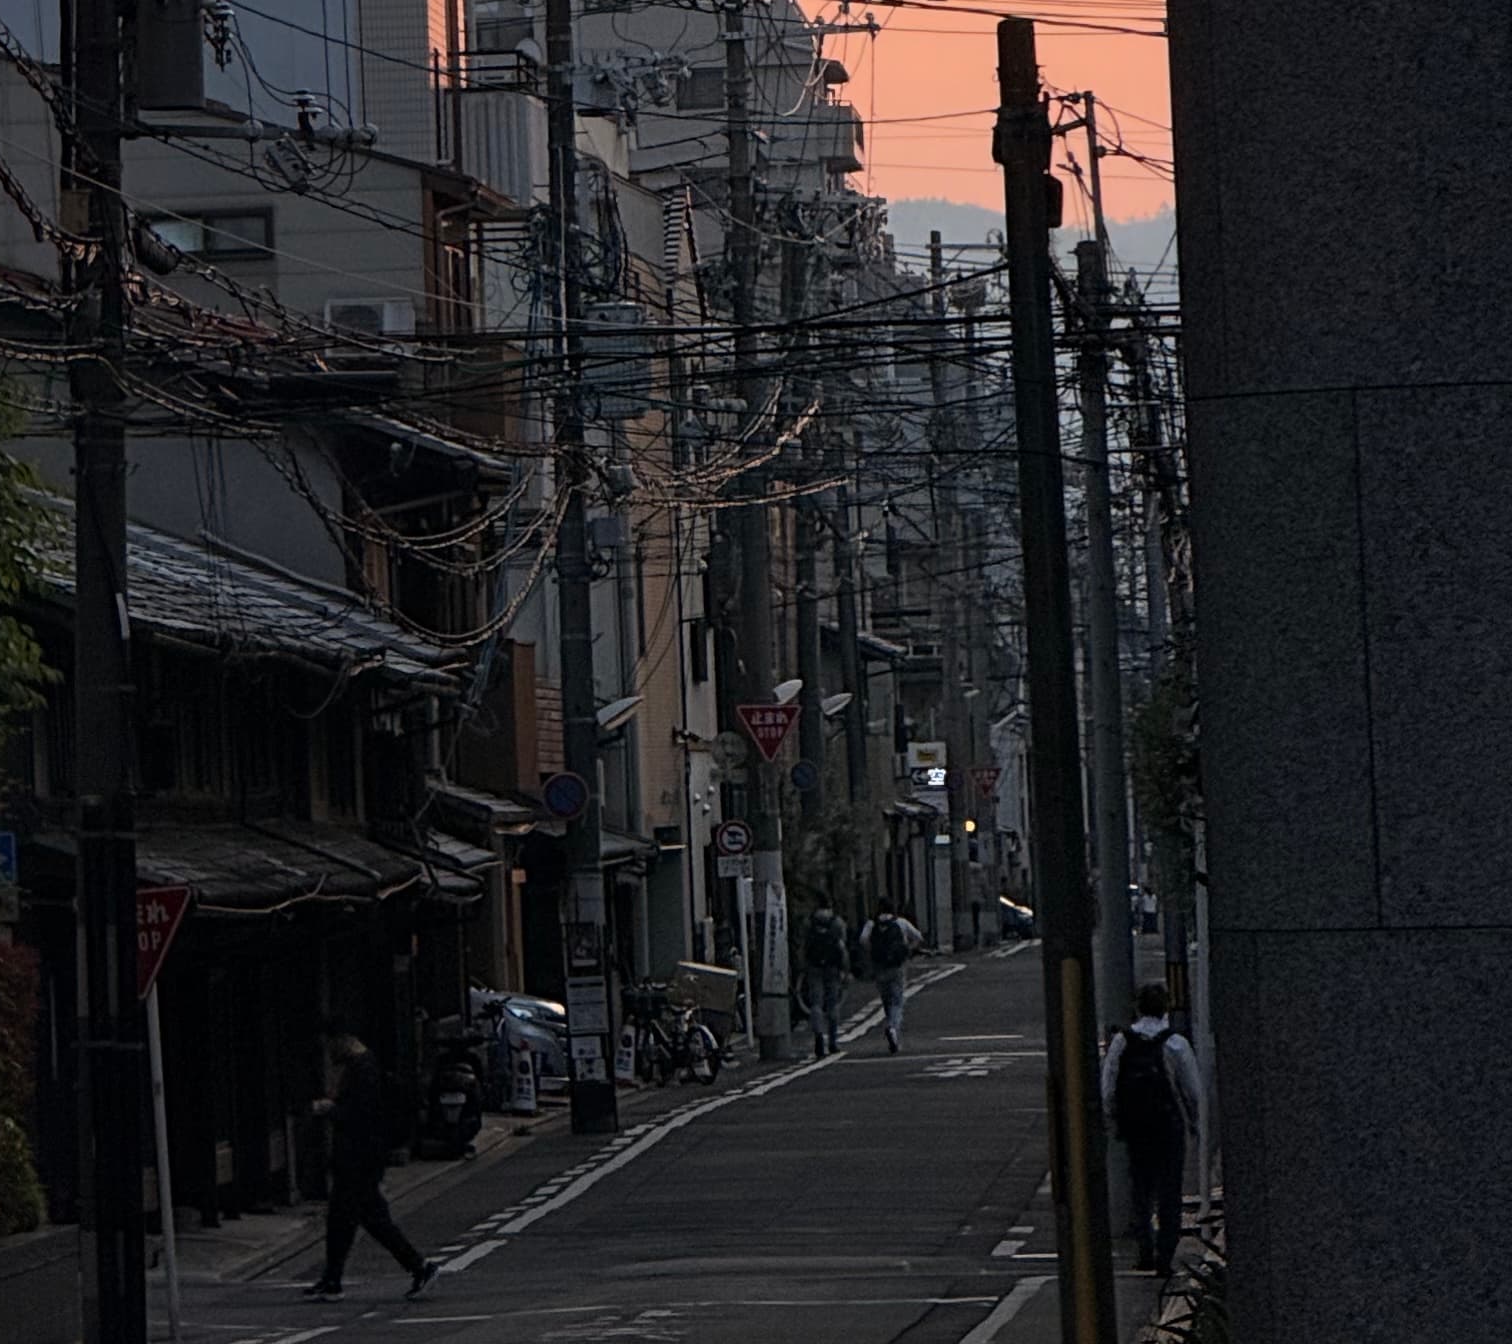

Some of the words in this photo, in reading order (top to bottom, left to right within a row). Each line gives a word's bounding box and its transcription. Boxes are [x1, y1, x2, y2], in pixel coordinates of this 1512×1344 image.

[751, 711, 788, 725] 止まれ
[757, 726, 783, 738] STOP
[138, 931, 162, 951] OP
